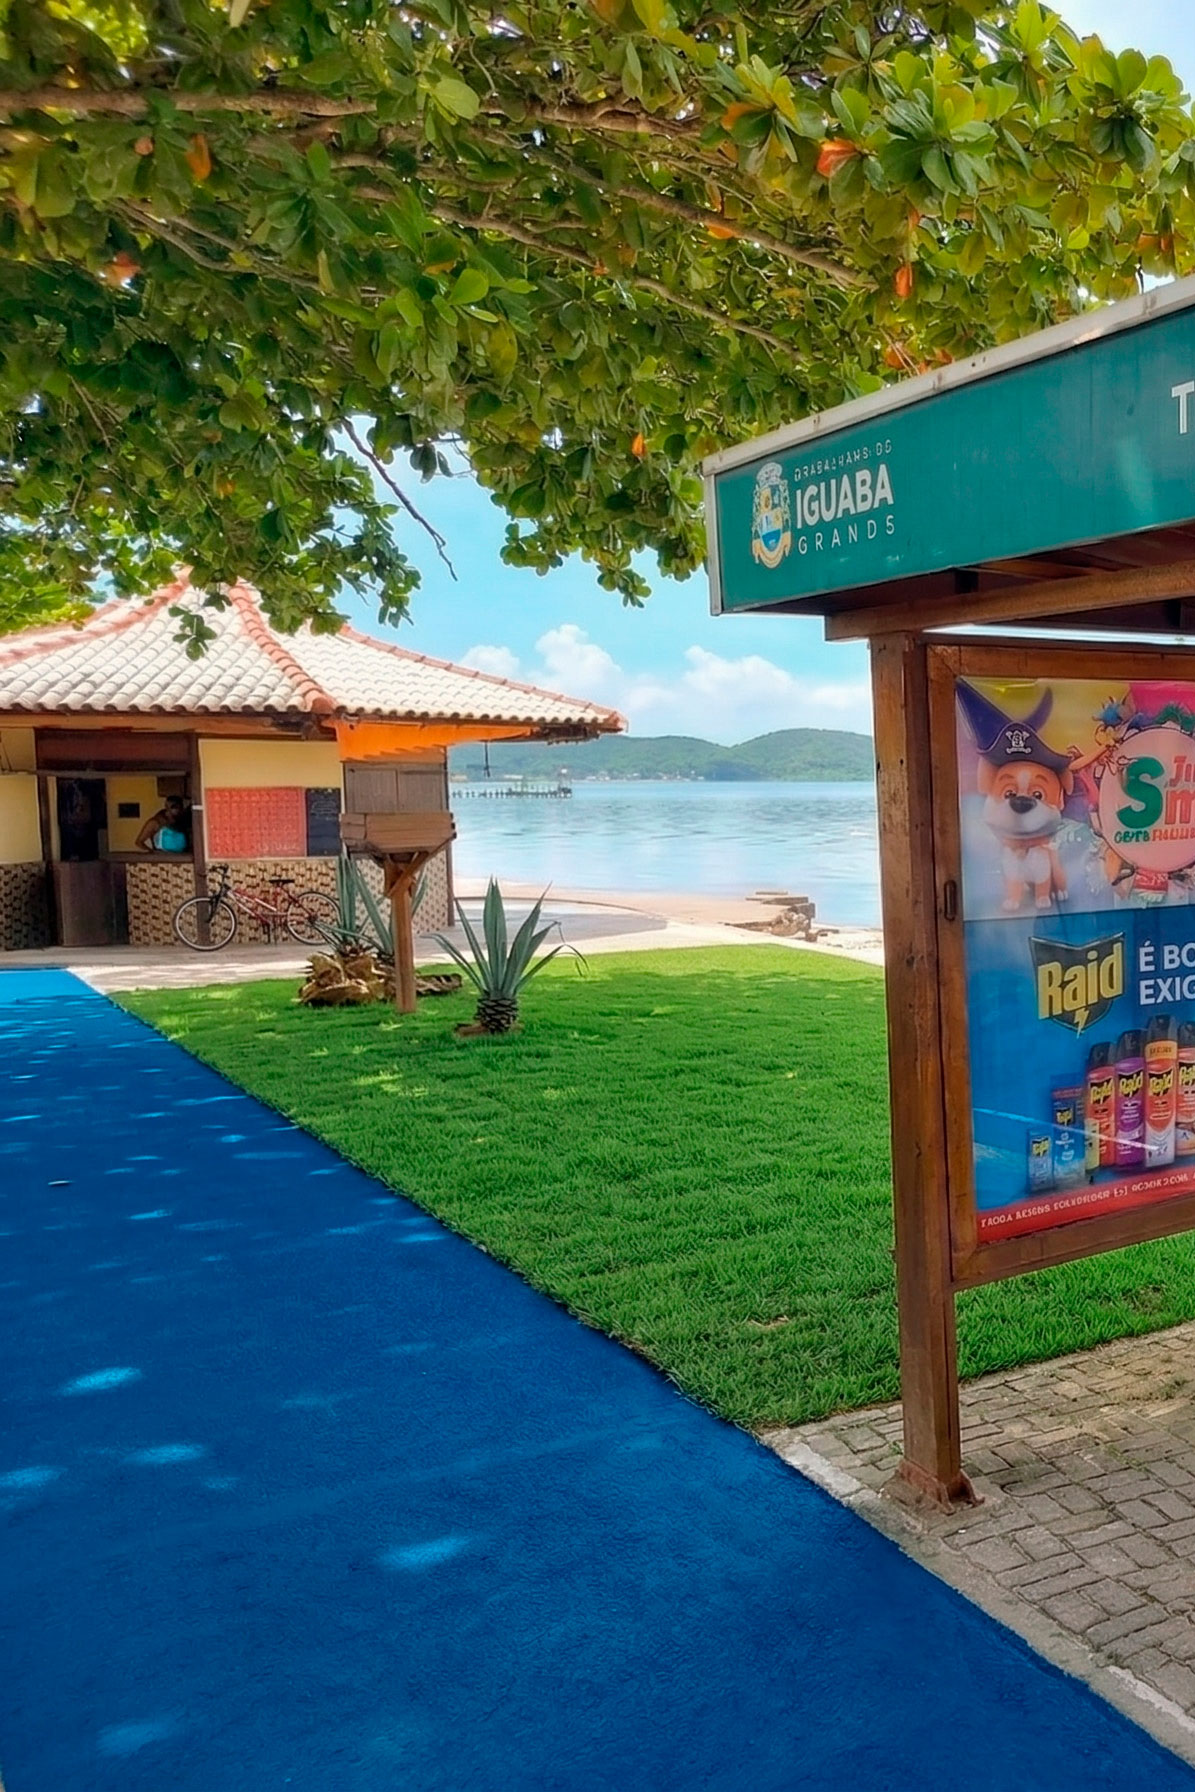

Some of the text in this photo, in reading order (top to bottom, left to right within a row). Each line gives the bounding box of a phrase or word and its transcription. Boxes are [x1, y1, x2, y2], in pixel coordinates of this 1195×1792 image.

[796, 463, 895, 529] IGUABA
[1037, 942, 1124, 1020] Raid
[1139, 940, 1155, 972] É
